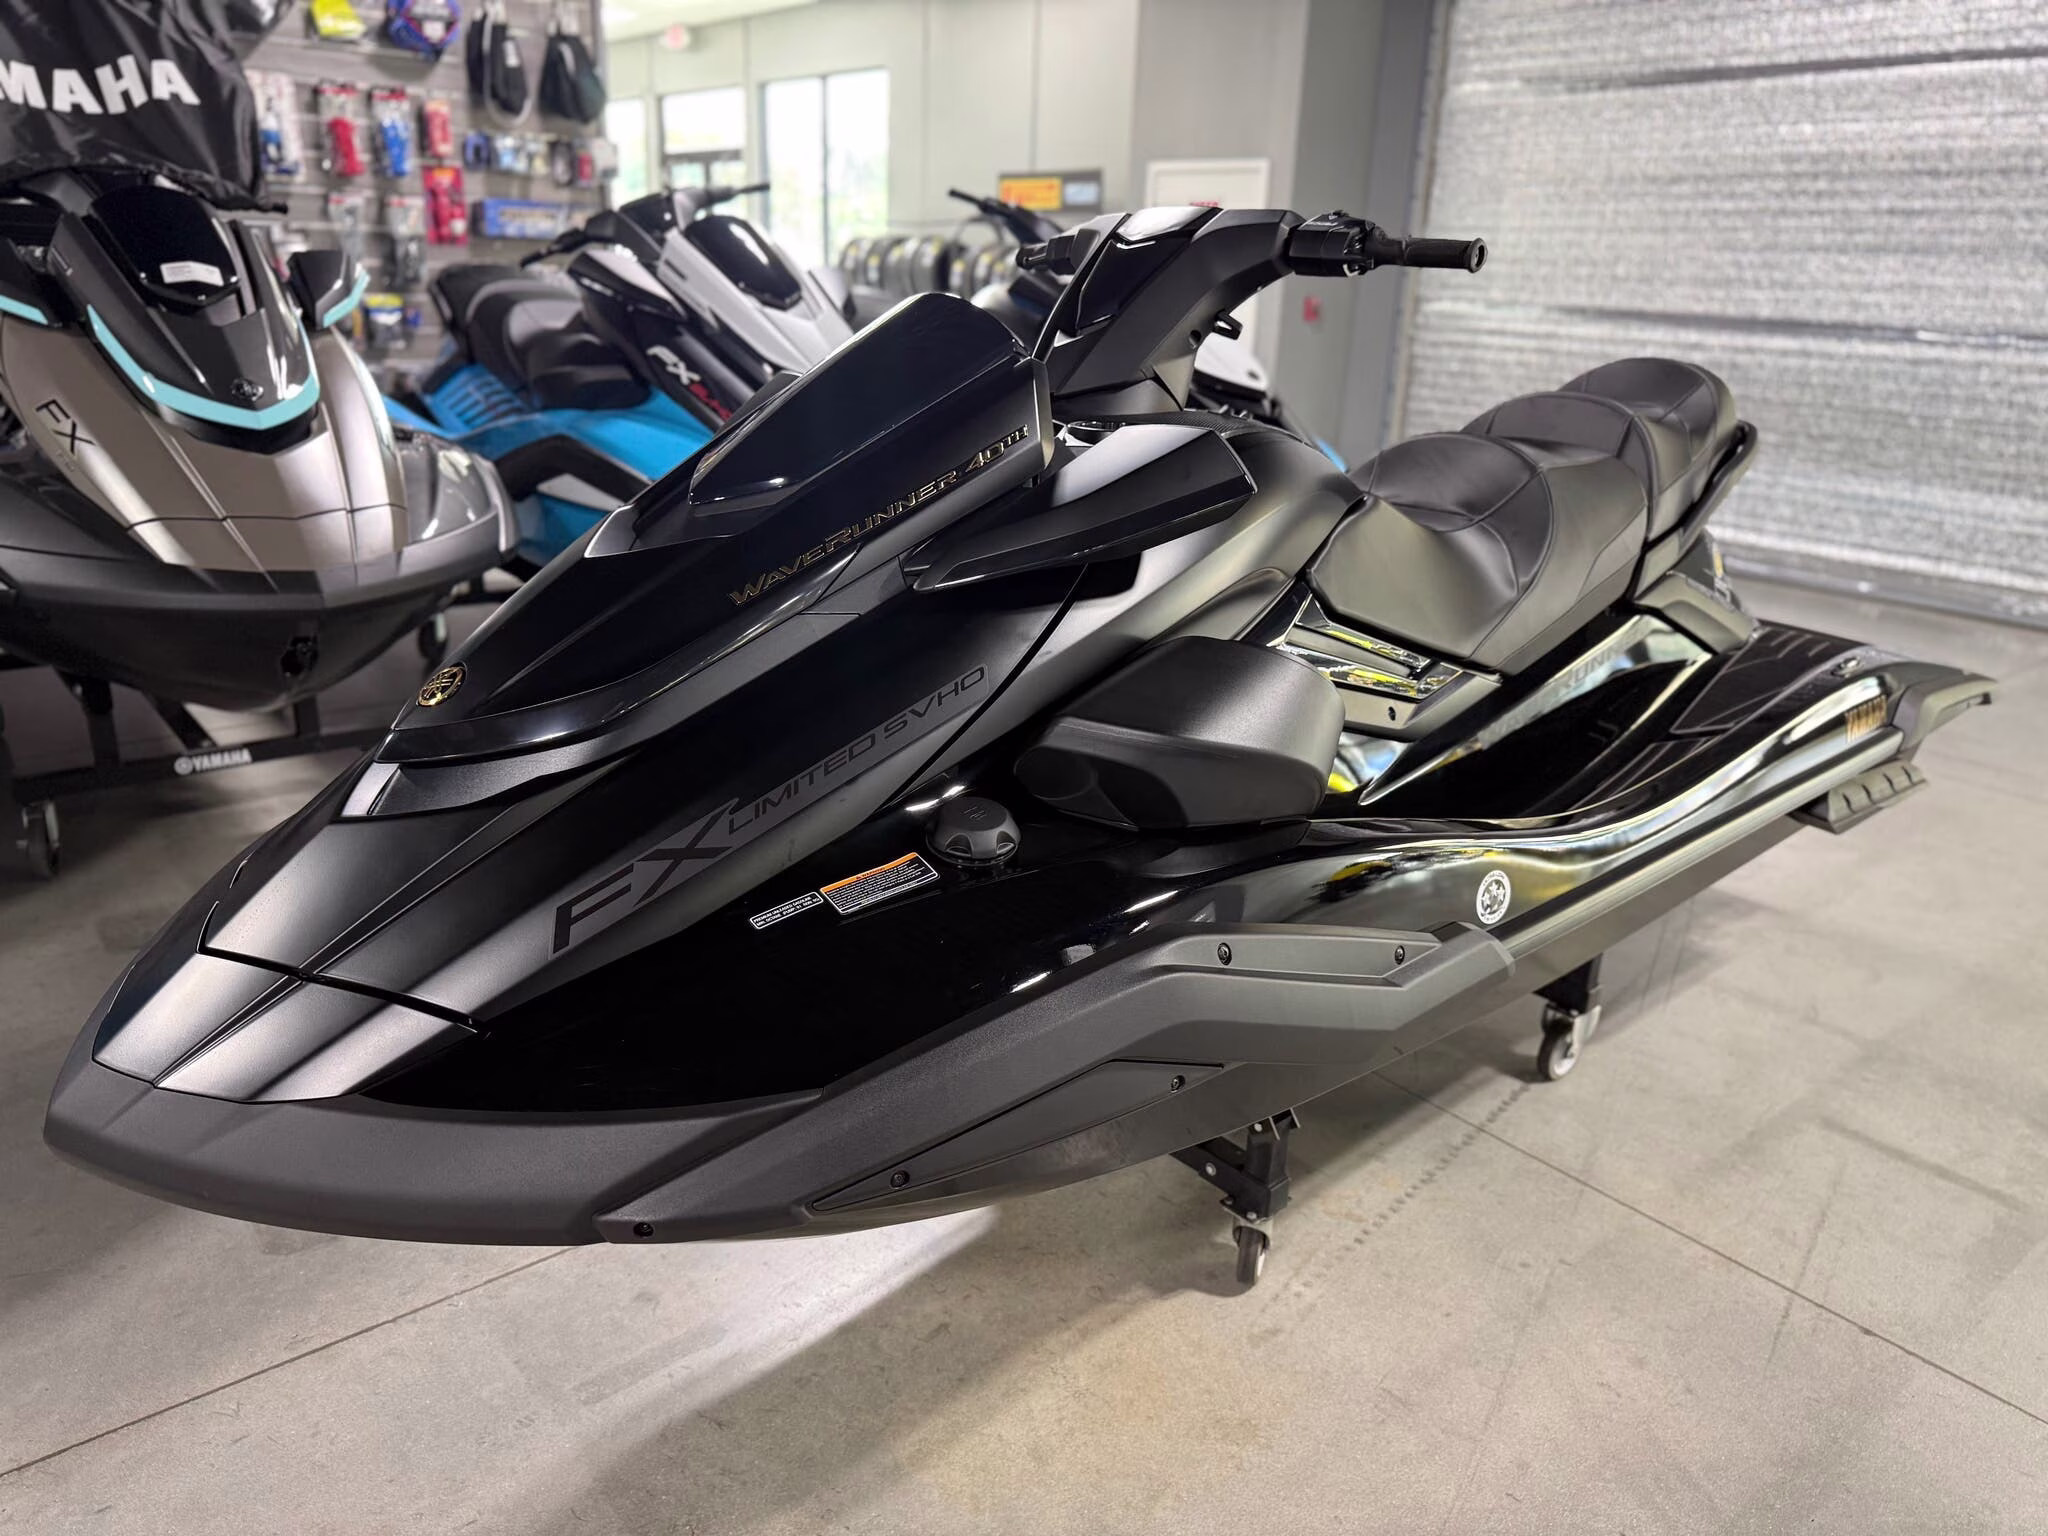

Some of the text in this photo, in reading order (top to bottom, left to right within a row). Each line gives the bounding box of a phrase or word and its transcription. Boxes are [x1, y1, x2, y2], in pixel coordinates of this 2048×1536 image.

[646, 345, 701, 385] FX
[35, 398, 96, 454] FX
[728, 424, 1029, 606] WAVERUNNER 40TH
[192, 748, 252, 771] YAMAHA
[728, 666, 985, 836] LIMITED SVHO
[553, 803, 732, 953] FX
